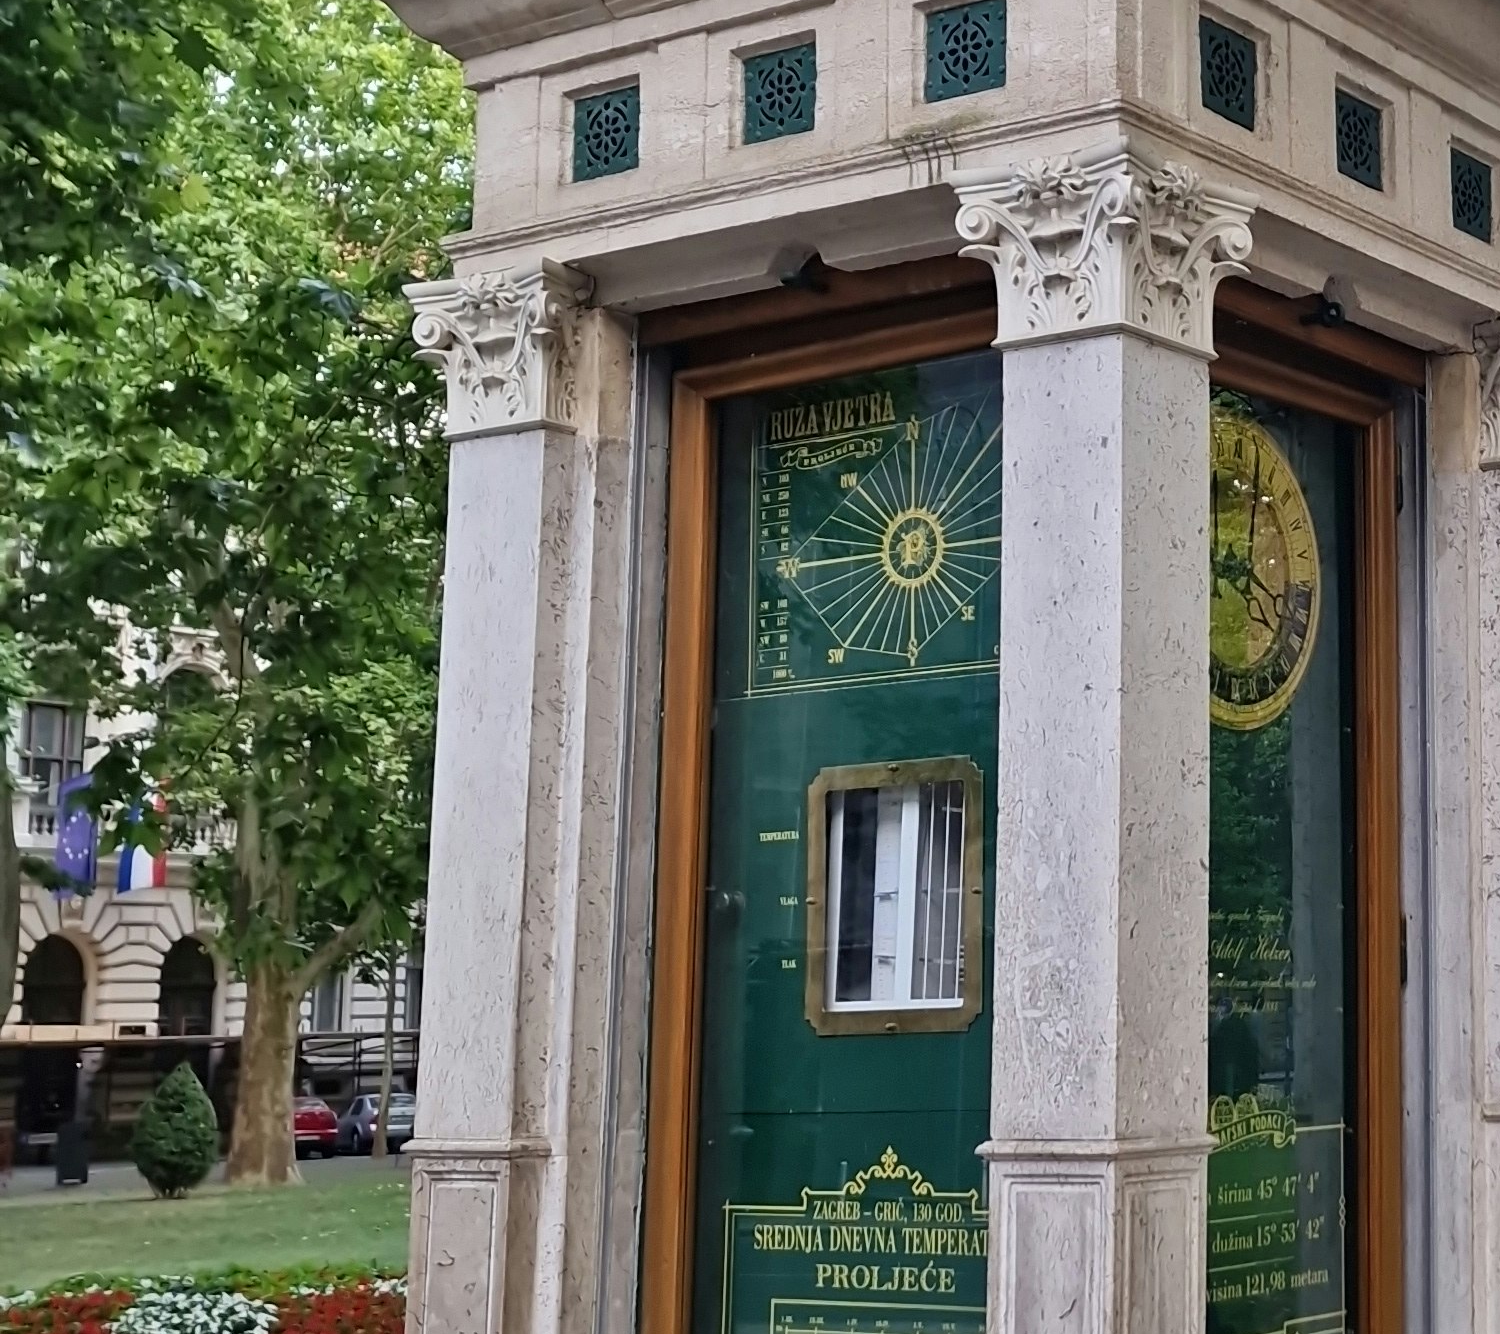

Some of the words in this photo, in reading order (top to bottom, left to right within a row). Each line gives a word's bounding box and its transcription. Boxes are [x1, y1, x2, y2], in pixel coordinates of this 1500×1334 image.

[823, 392, 896, 431] VJETRA
[840, 472, 858, 488] NW
[1297, 549, 1309, 560] V
[961, 605, 975, 621] SE
[827, 648, 845, 663] SW
[760, 831, 799, 842] TEMPERATURA
[780, 897, 798, 906] VLAGA
[1250, 1115, 1282, 1133] PODACI
[1217, 1181, 1252, 1206] širina
[813, 1200, 861, 1220] ZAGREB
[874, 1197, 908, 1224] GRIČ,
[912, 1202, 932, 1223] 130
[935, 1203, 966, 1223] GOD.
[753, 1224, 824, 1254] SREDNJA
[829, 1225, 897, 1254] DNEVNA
[1212, 1230, 1253, 1254] dužina
[815, 1260, 956, 1294] PROLJEĆE
[1246, 1269, 1286, 1296] 121,98
[1290, 1269, 1329, 1288] metara
